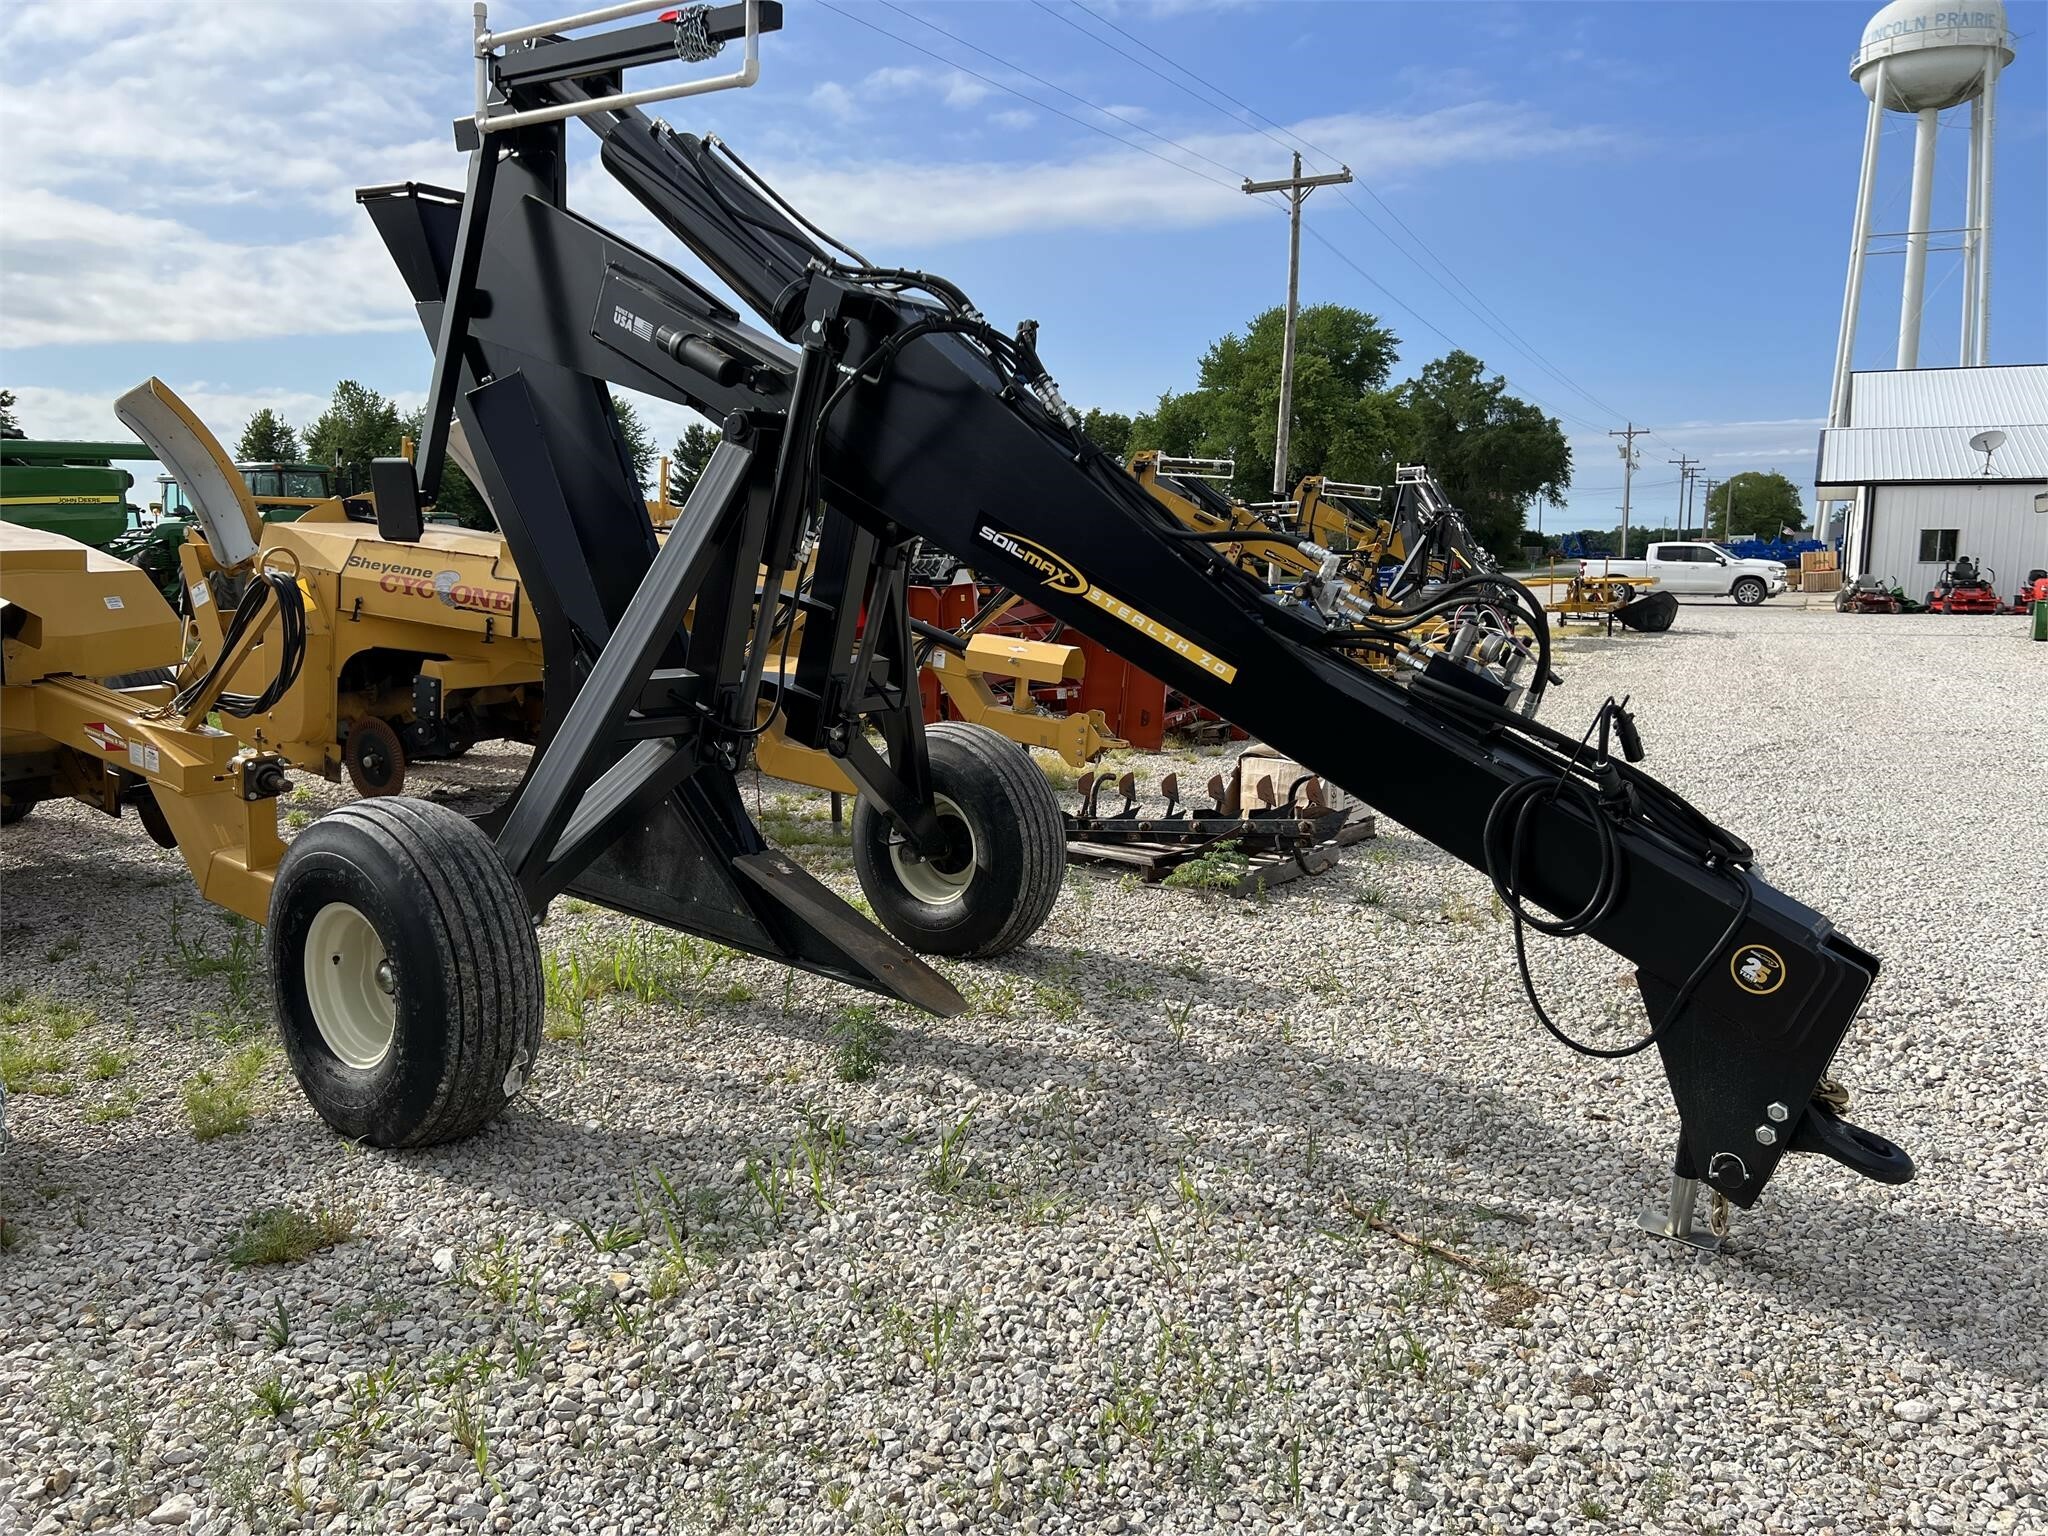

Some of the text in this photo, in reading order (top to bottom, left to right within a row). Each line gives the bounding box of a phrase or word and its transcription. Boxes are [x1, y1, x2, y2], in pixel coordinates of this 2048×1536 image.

[1866, 12, 1996, 42] INCOLN PRAIRIE
[613, 311, 632, 332] USA
[78, 496, 101, 504] DEERE
[348, 556, 433, 578] Sheyenne
[979, 525, 1070, 585] SOIL-MAX
[1090, 590, 1189, 653] STEALTH
[1741, 957, 1772, 984] 25
